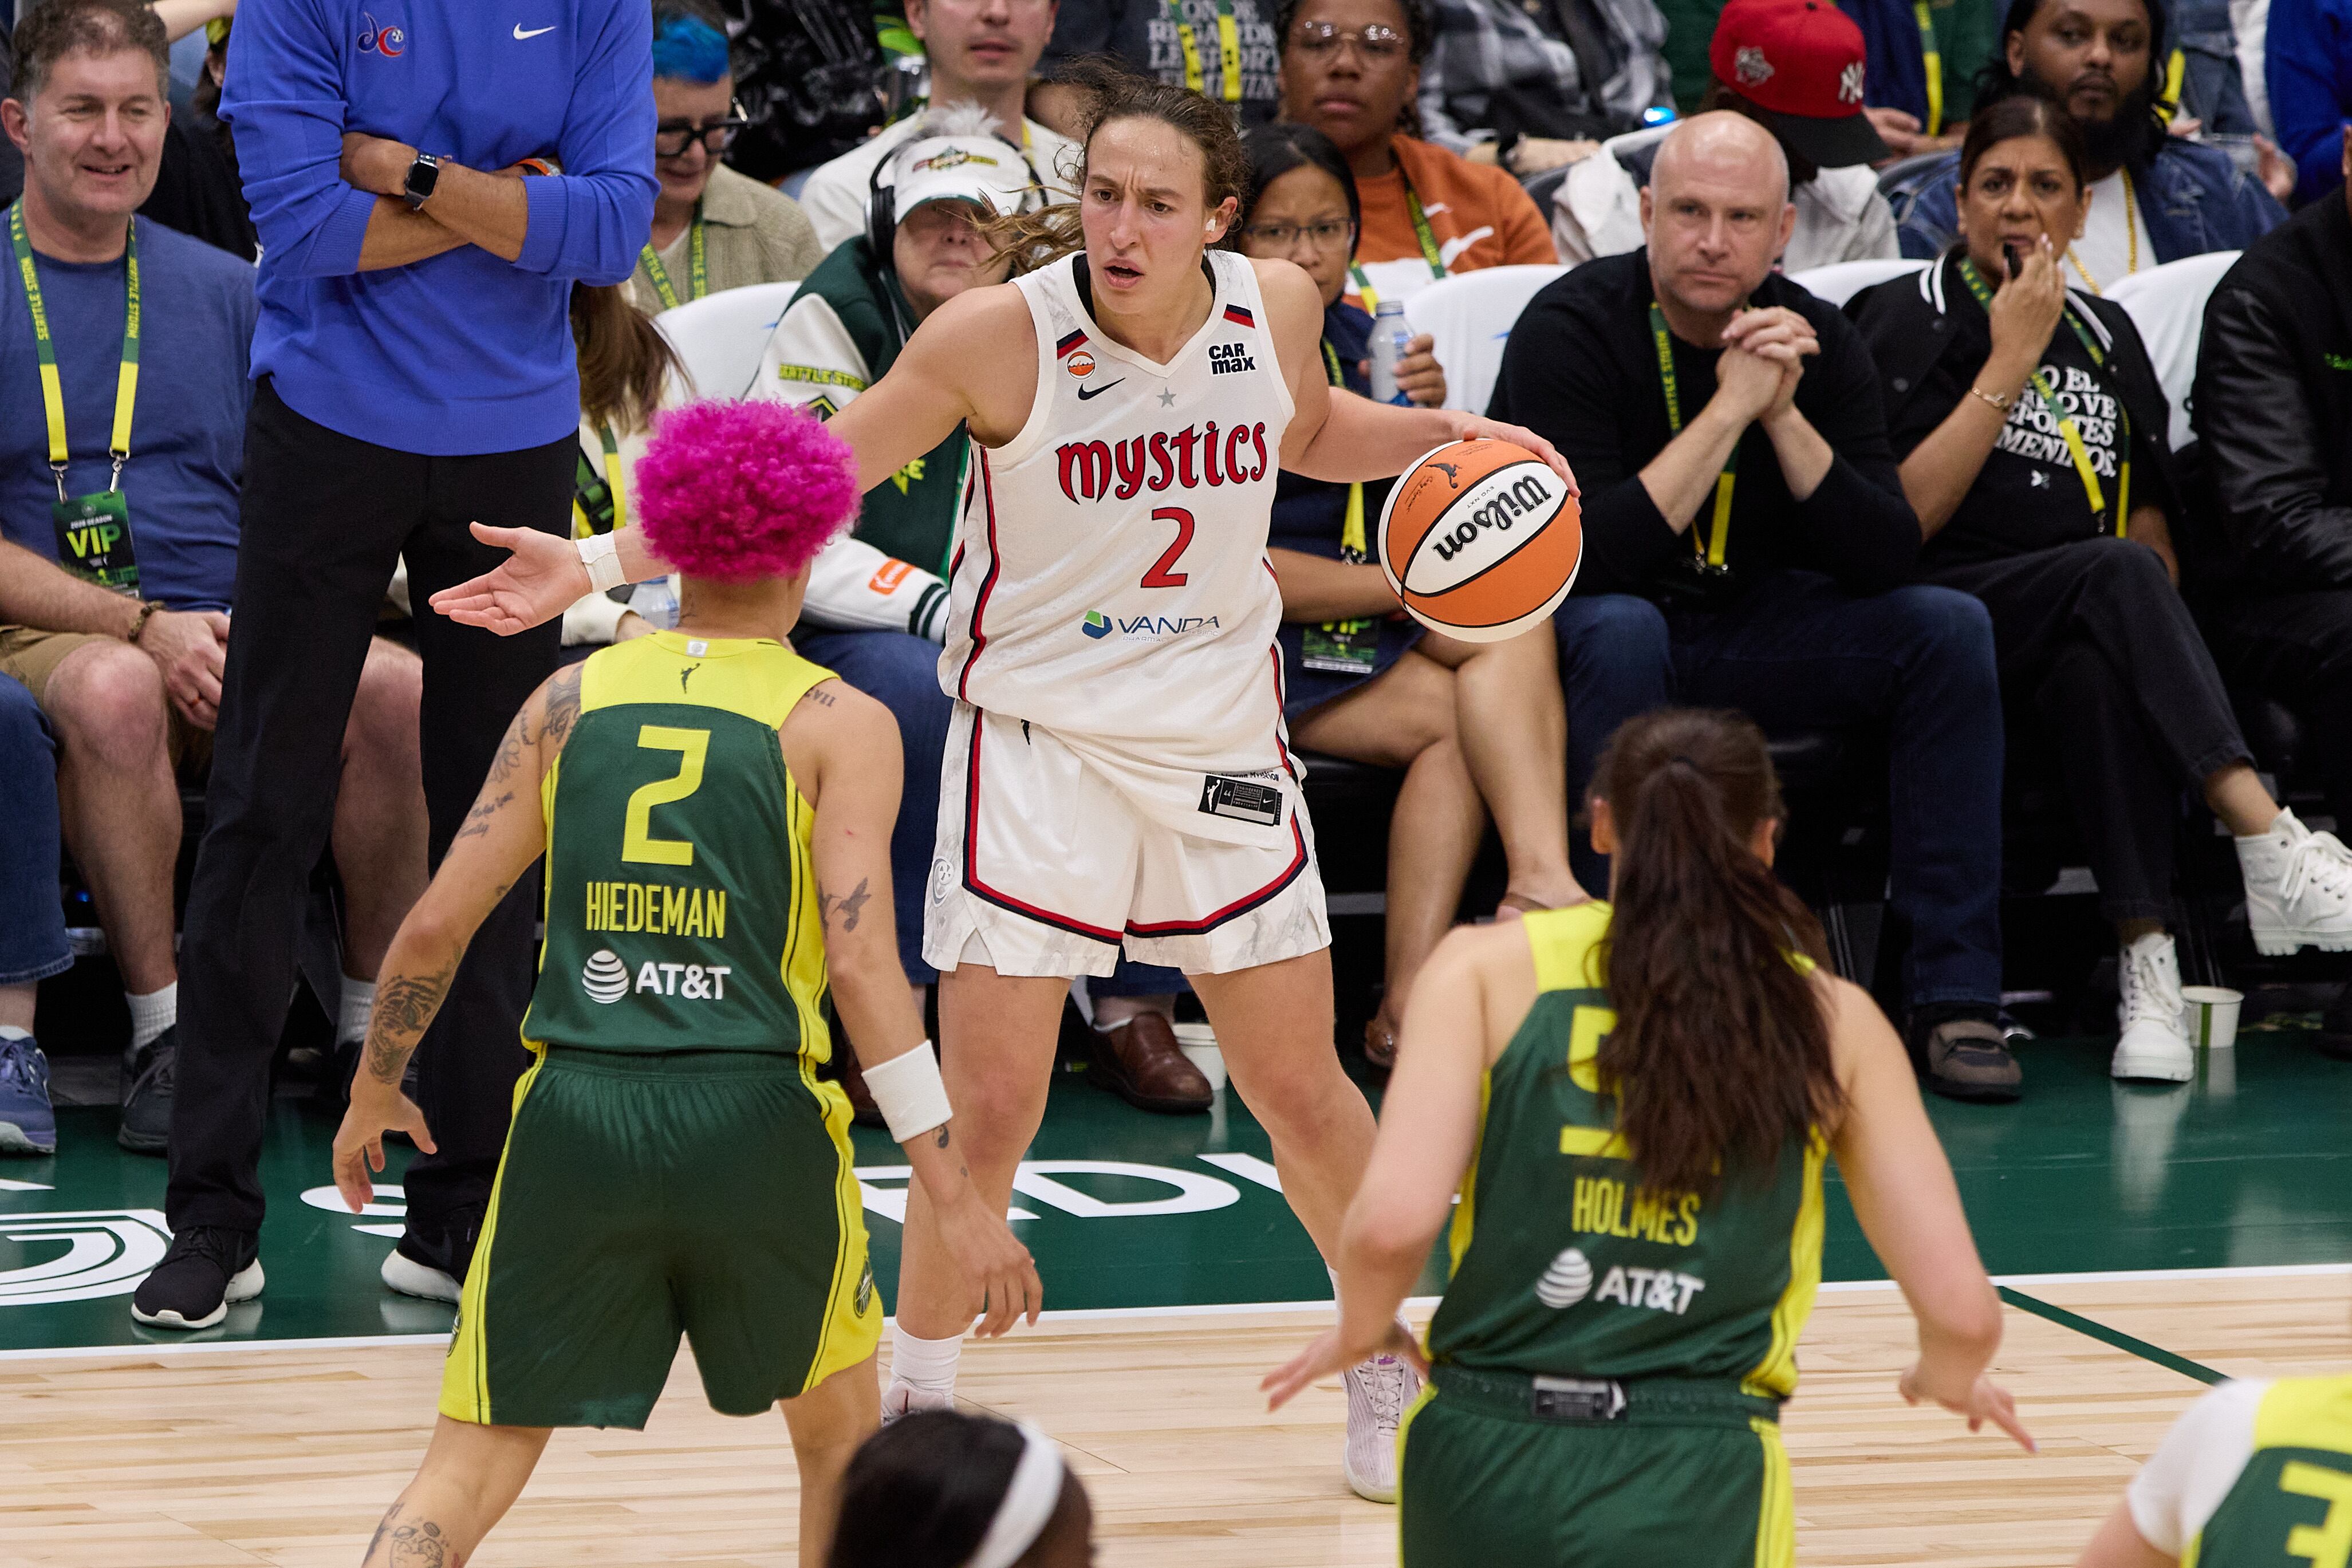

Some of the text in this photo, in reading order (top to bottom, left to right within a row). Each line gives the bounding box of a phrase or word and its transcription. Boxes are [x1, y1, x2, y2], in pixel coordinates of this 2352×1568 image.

[1208, 342, 1245, 360] CAR
[1211, 356, 1256, 375] max
[2065, 367, 2101, 393] EL
[2081, 392, 2118, 420] VE
[1433, 475, 1552, 561] Wilson
[1467, 497, 1480, 509] NXT
[66, 524, 121, 558] VIP
[1140, 506, 1195, 588] 2
[1118, 616, 1220, 634] VANDA
[622, 725, 711, 866] 2
[586, 881, 727, 939] HIEDEMAN
[635, 960, 732, 1000] AT&T
[1572, 1176, 1701, 1247] HOLMES
[1594, 1264, 1705, 1315] AT&T
